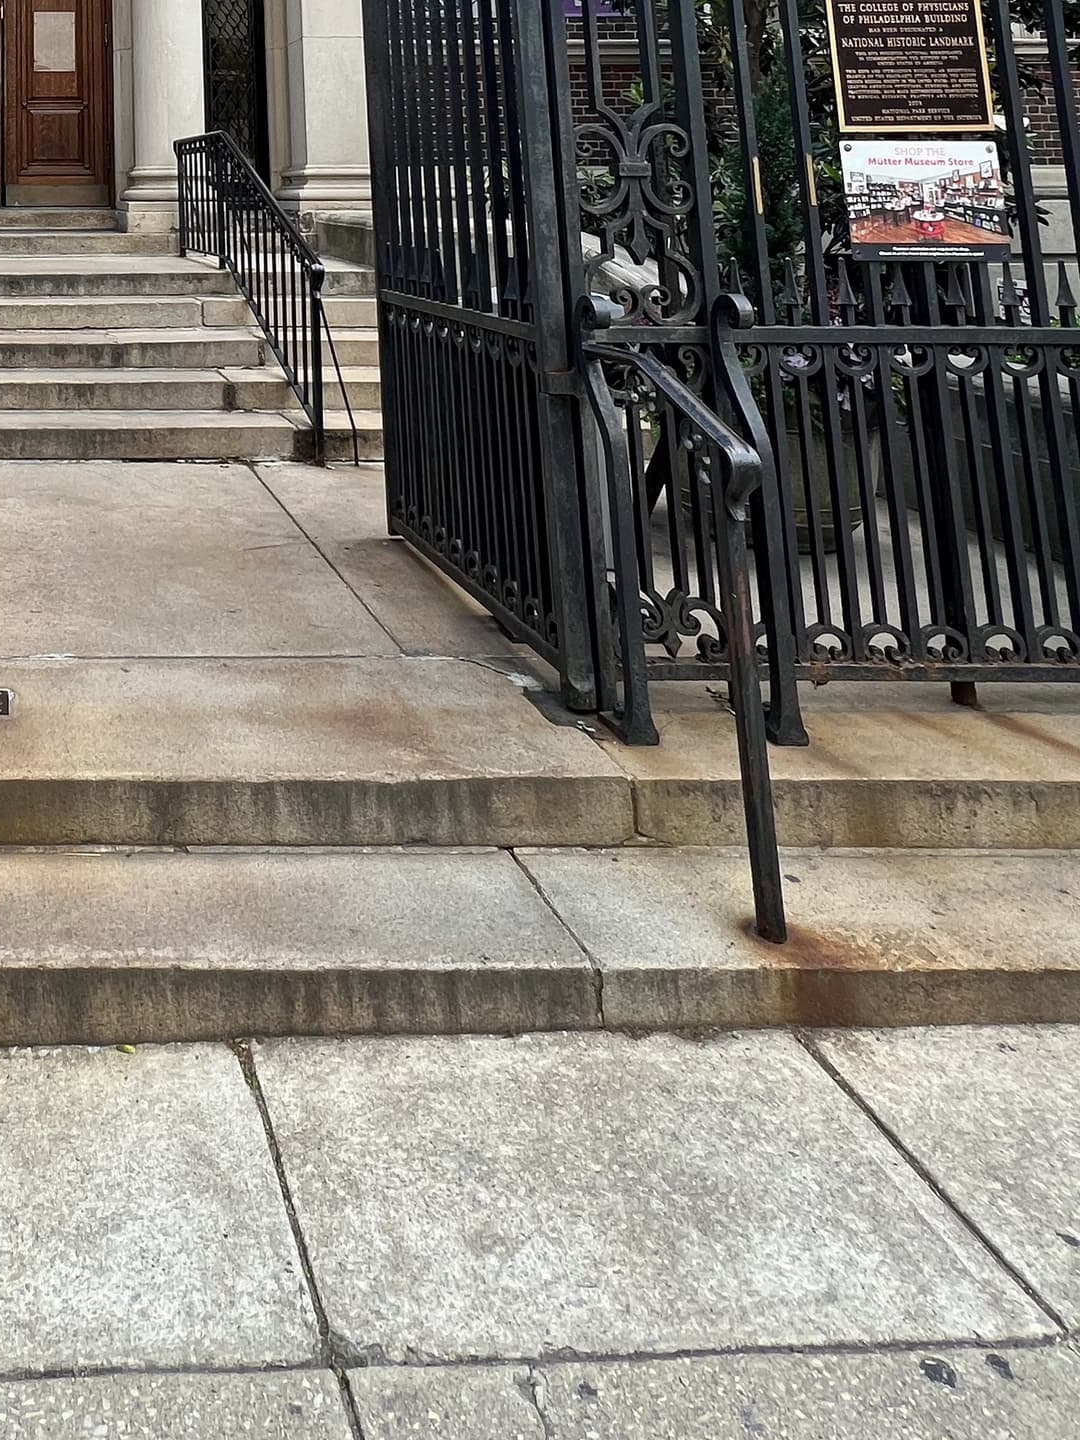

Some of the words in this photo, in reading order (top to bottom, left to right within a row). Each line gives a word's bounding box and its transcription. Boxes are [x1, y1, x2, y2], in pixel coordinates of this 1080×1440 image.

[837, 3, 857, 13] THE
[859, 3, 900, 13] COLLEGE
[902, 3, 914, 12] OF
[917, 2, 970, 12] PHYSICIANS
[842, 15, 855, 25] OF
[858, 14, 921, 24] PHILADELPHIA
[924, 14, 969, 23] BUILDING
[840, 37, 885, 48] NATIONAL
[886, 37, 927, 47] HISTORIC
[929, 36, 975, 47] LANDMARK
[894, 147, 923, 157] SHOP
[925, 147, 946, 157] THE
[904, 157, 947, 166] Museum
[948, 157, 975, 166] Store
